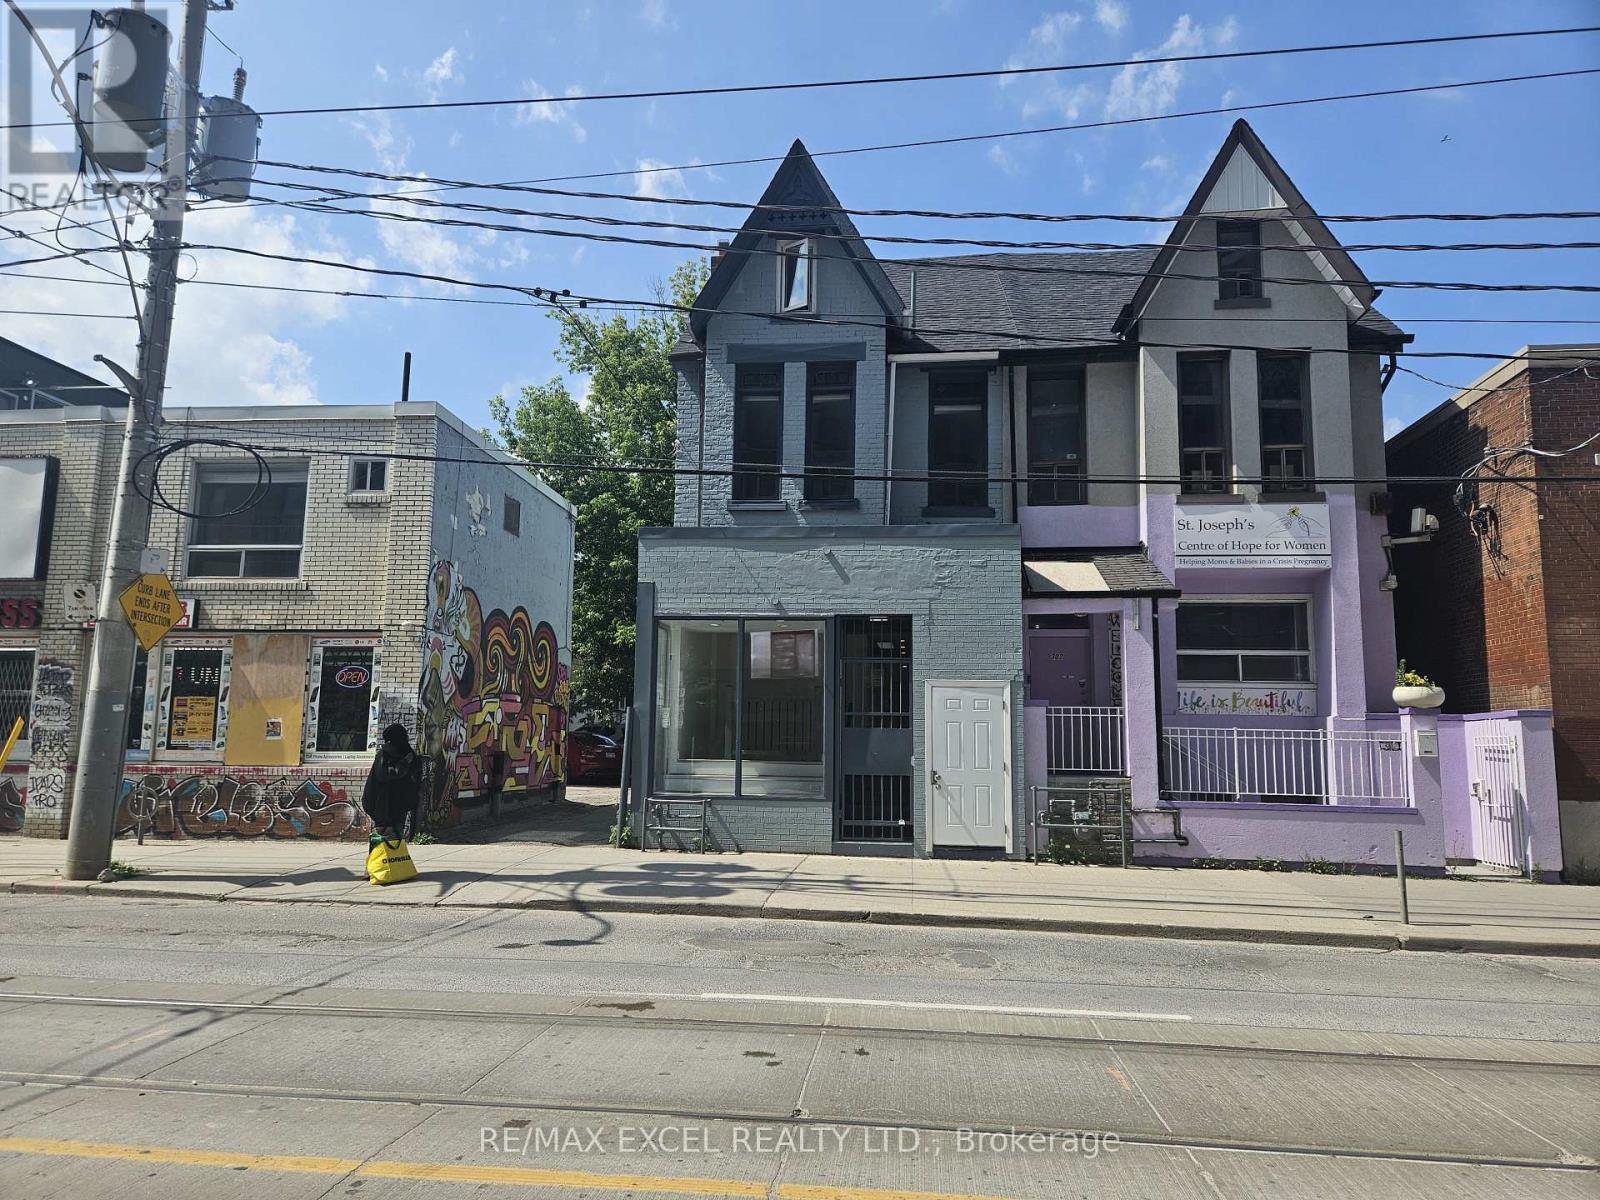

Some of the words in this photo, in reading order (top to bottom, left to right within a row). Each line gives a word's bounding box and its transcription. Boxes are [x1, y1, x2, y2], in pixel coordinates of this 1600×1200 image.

[1177, 518, 1194, 531] St.
[1198, 517, 1255, 533] Joseph's
[1178, 541, 1215, 551] Centre
[1217, 540, 1230, 551] of
[1232, 540, 1262, 553] Hope
[1265, 540, 1281, 551] for
[1283, 541, 1327, 551] Women
[1179, 558, 1206, 566] Helping
[1293, 558, 1328, 566] Pregnancy
[138, 582, 154, 596] CURB
[155, 586, 171, 600] LANE
[135, 596, 151, 609] ENDS
[152, 599, 171, 614] AFTER
[130, 609, 171, 627] INTERSECTION
[338, 671, 367, 683] OPEN
[1177, 690, 1206, 711] Life
[1211, 694, 1229, 708] is
